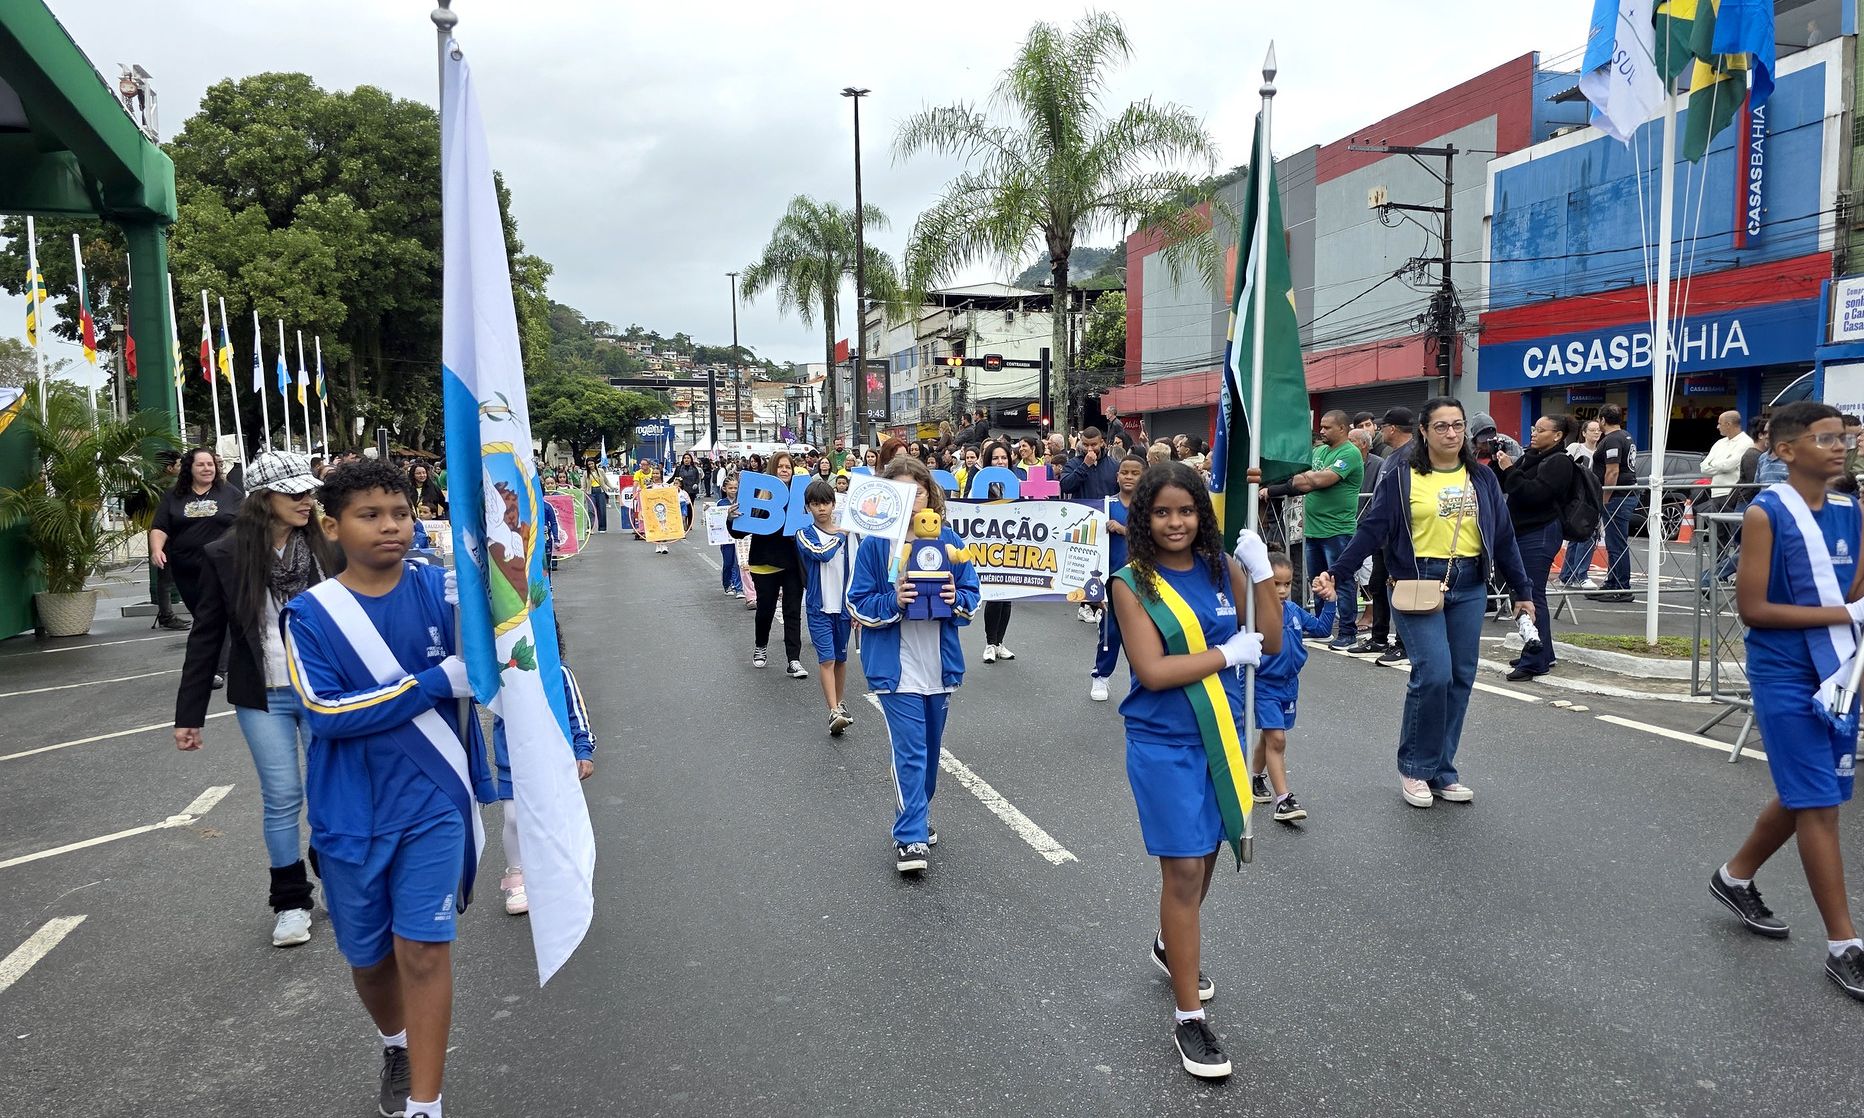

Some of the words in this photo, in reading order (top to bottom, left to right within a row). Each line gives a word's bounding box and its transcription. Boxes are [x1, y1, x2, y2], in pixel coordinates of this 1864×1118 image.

[1844, 311, 1850, 321] o
[867, 409, 885, 418] 9:43
[1005, 575, 1023, 583] LOMEU
[1023, 576, 1044, 585] BASTOS
